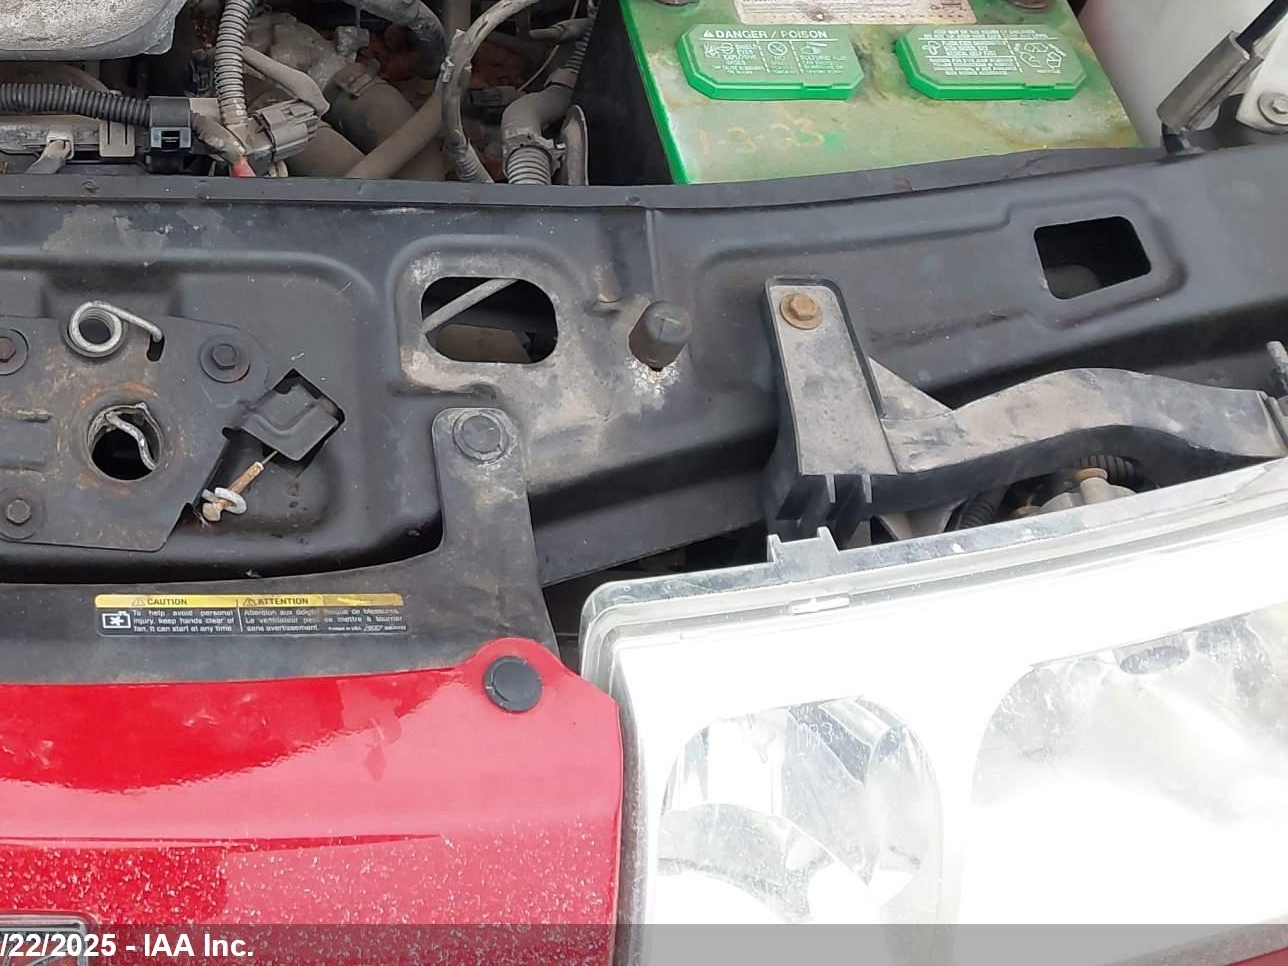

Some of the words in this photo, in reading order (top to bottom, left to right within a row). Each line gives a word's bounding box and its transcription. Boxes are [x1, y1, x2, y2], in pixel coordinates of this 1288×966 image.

[715, 30, 768, 39] DANGER
[780, 30, 828, 39] POISON
[258, 597, 309, 605] ATTENTION
